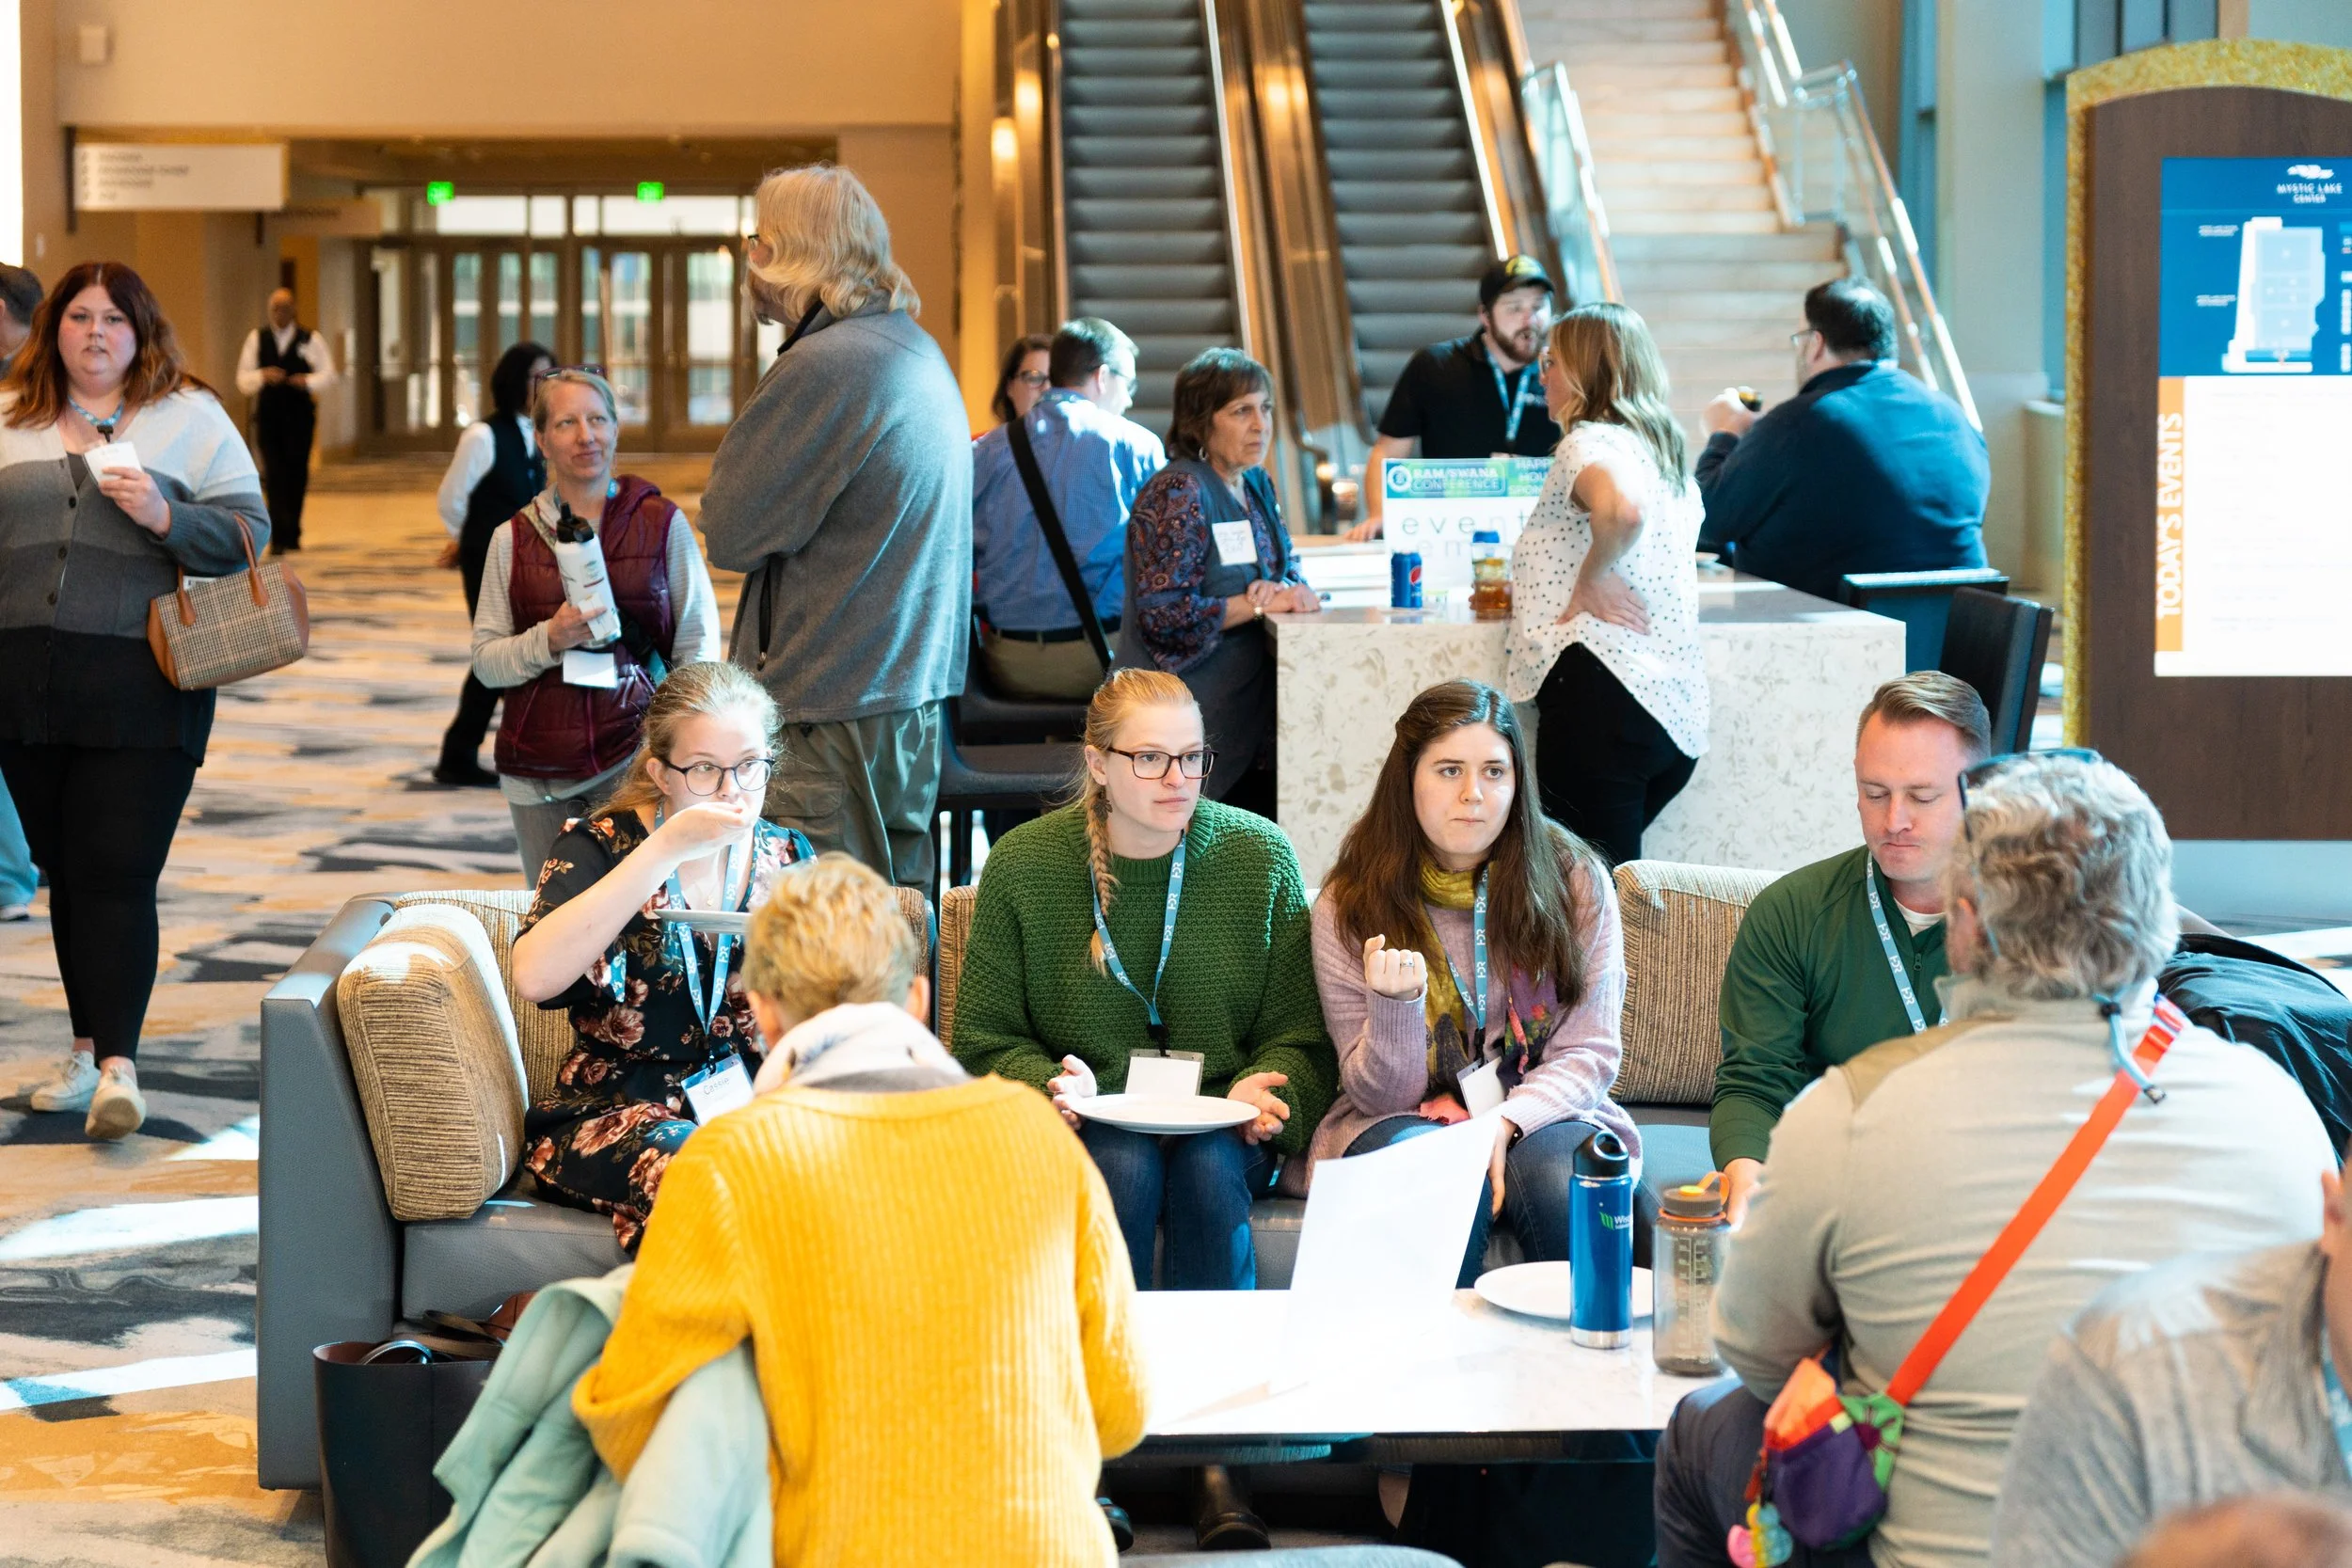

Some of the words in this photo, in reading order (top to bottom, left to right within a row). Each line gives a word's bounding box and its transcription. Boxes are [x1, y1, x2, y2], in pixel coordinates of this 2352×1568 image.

[2277, 182, 2314, 194] MYSTIC
[2317, 182, 2343, 194] LAKE
[1516, 459, 1552, 469] HAPP
[2157, 412, 2183, 508] EVENTS
[1518, 471, 1548, 483] HOU
[1413, 478, 1500, 490] CONFERENCE
[2157, 513, 2183, 620] TODAY'S
